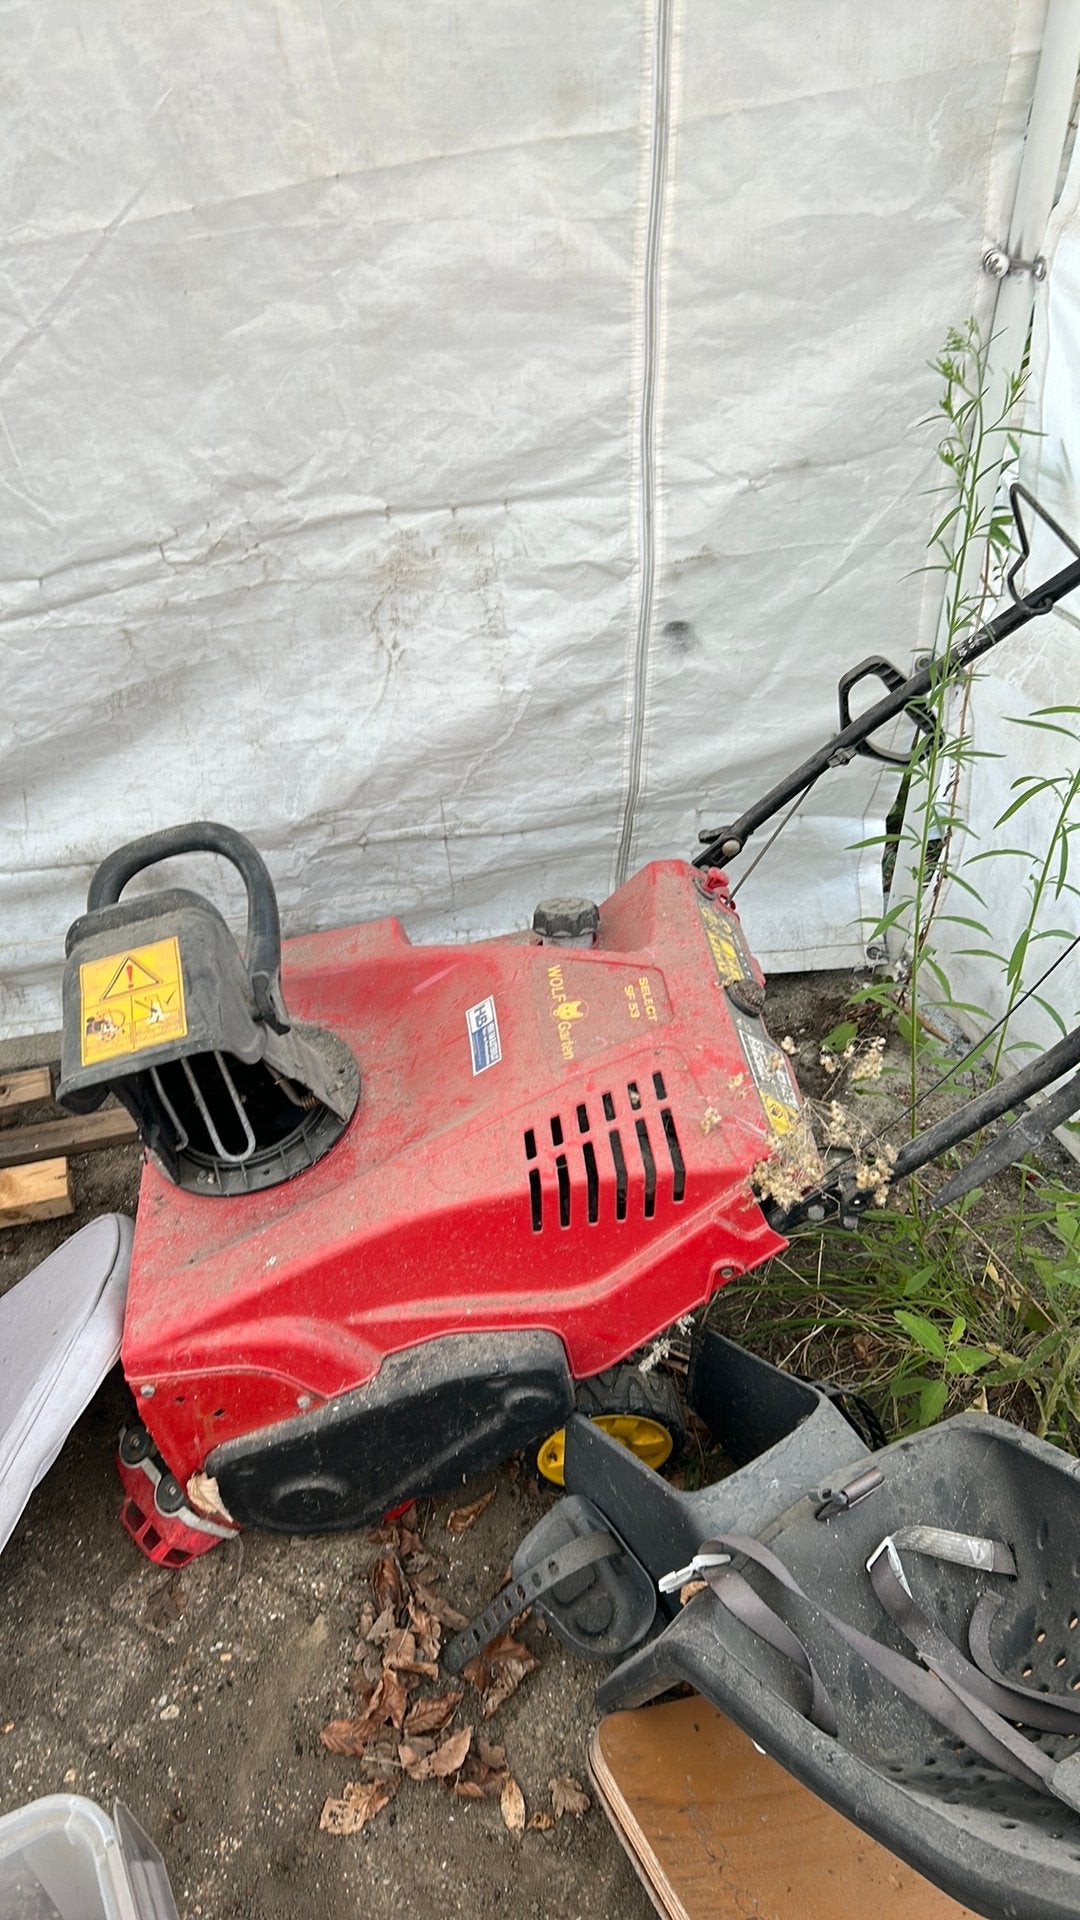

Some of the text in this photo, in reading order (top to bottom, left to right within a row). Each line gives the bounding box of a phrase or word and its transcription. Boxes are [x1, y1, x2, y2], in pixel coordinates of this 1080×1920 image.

[548, 965, 574, 1060] WOLF Garten
[624, 984, 640, 1019] SF 53
[638, 976, 658, 1021] SELECT
